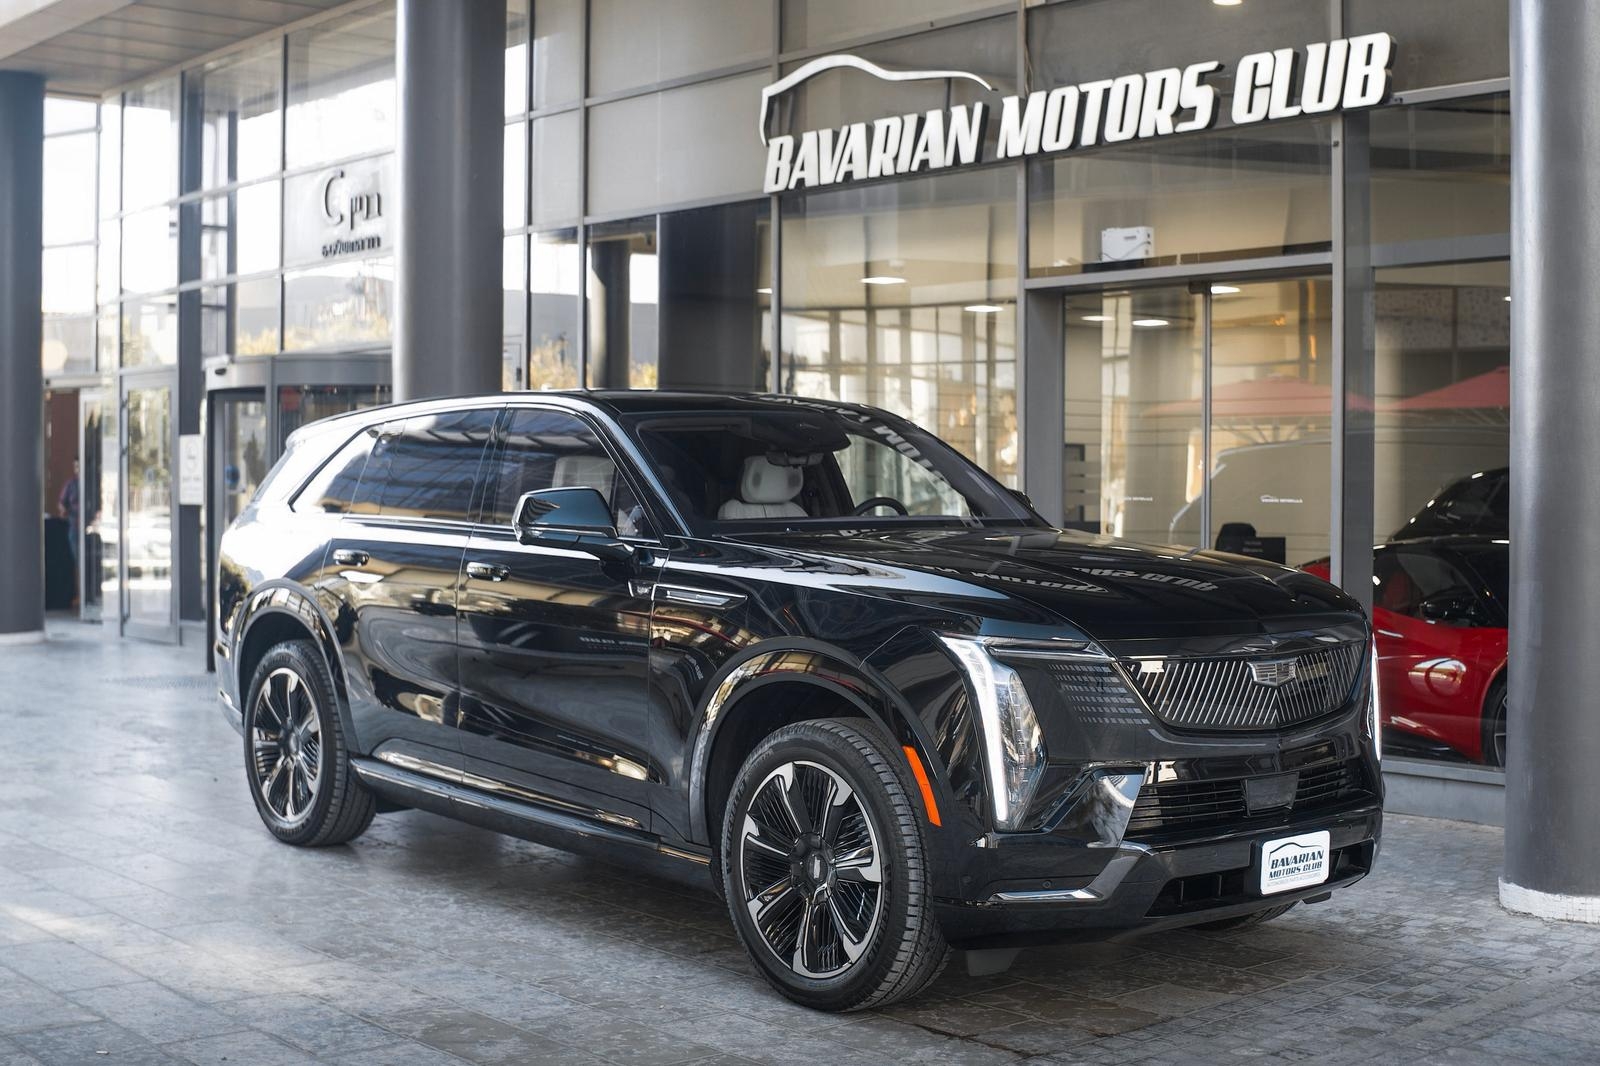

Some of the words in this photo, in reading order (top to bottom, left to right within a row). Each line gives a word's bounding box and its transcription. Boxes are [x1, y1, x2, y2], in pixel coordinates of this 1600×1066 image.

[763, 101, 984, 194] BAVARIAN
[996, 60, 1221, 159] MOTORS
[1231, 31, 1394, 125] CLUB
[1270, 849, 1324, 869] BAVARIAN
[1268, 867, 1301, 879] MOTORS
[1302, 861, 1322, 872] CLUB
